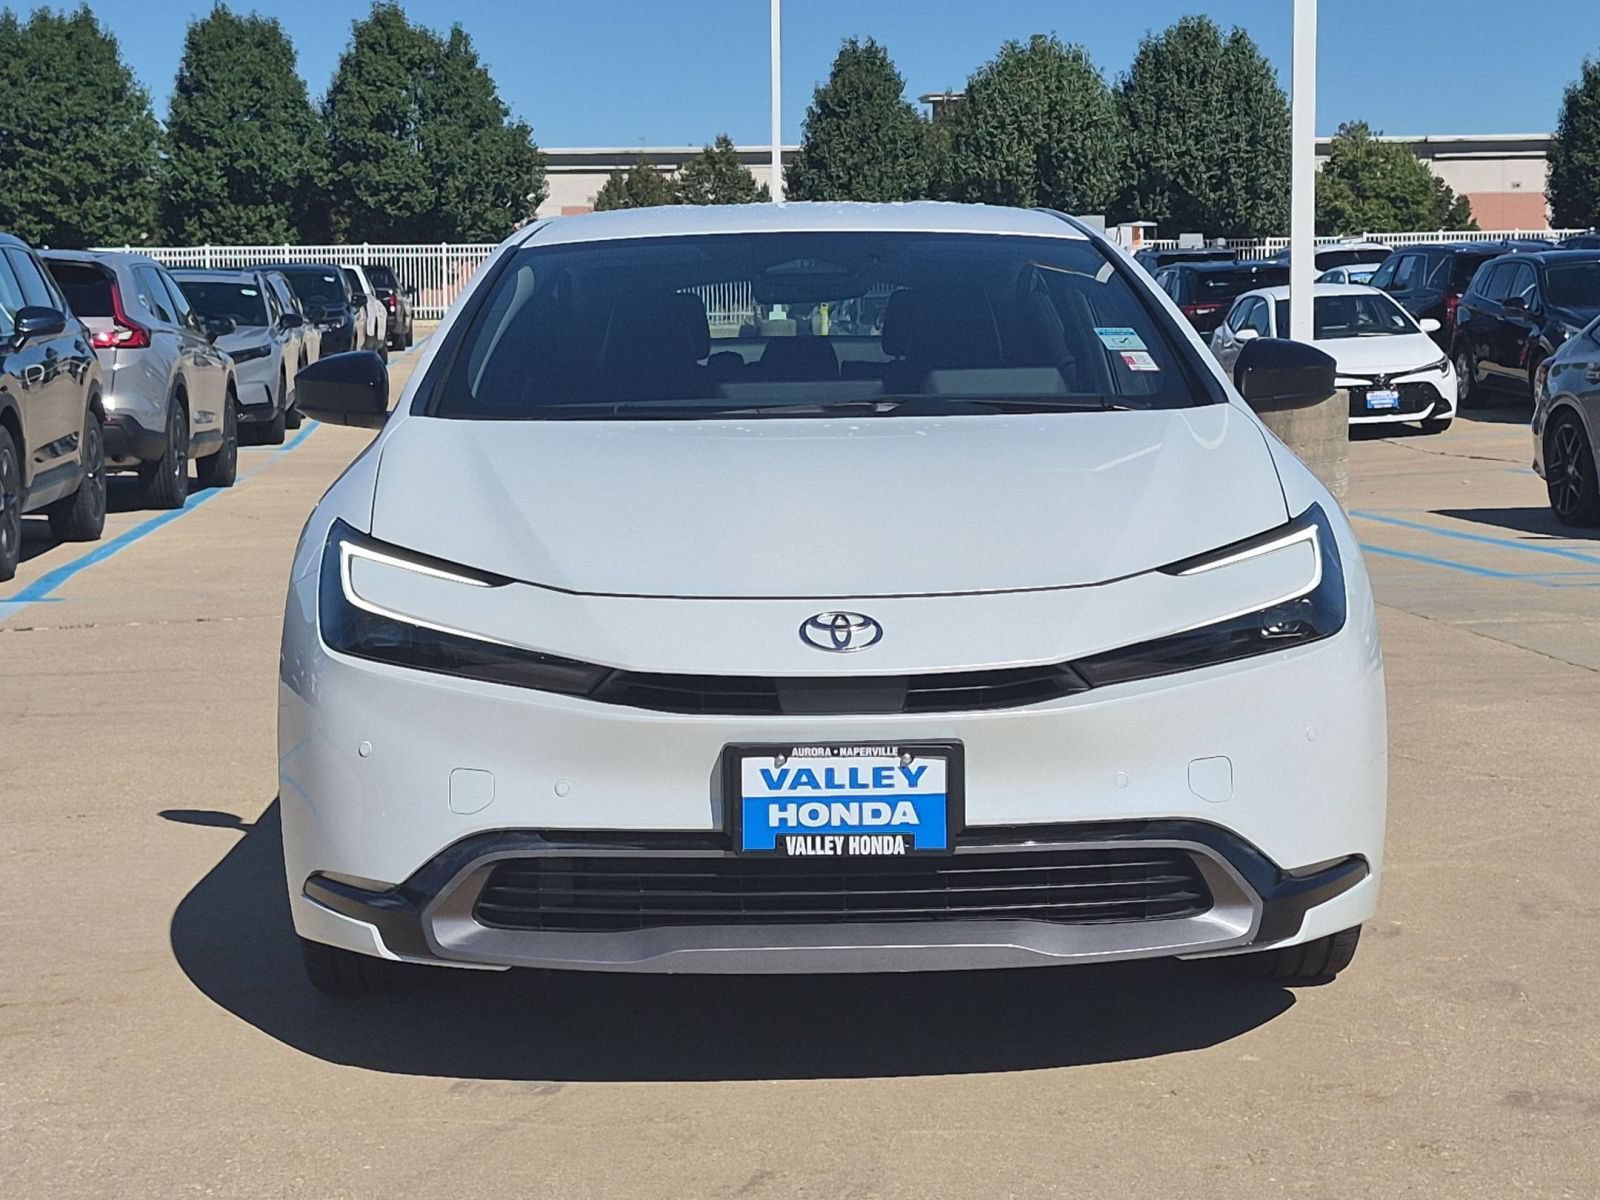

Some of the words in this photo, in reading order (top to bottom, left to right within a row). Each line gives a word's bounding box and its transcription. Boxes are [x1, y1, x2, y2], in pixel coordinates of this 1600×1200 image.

[791, 747, 832, 757] AURORA
[839, 746, 898, 757] NAPERVILLE
[759, 765, 928, 790] VALLEY
[768, 801, 920, 827] HONDA
[785, 836, 845, 856] VALLEY
[848, 835, 906, 855] HONDA
